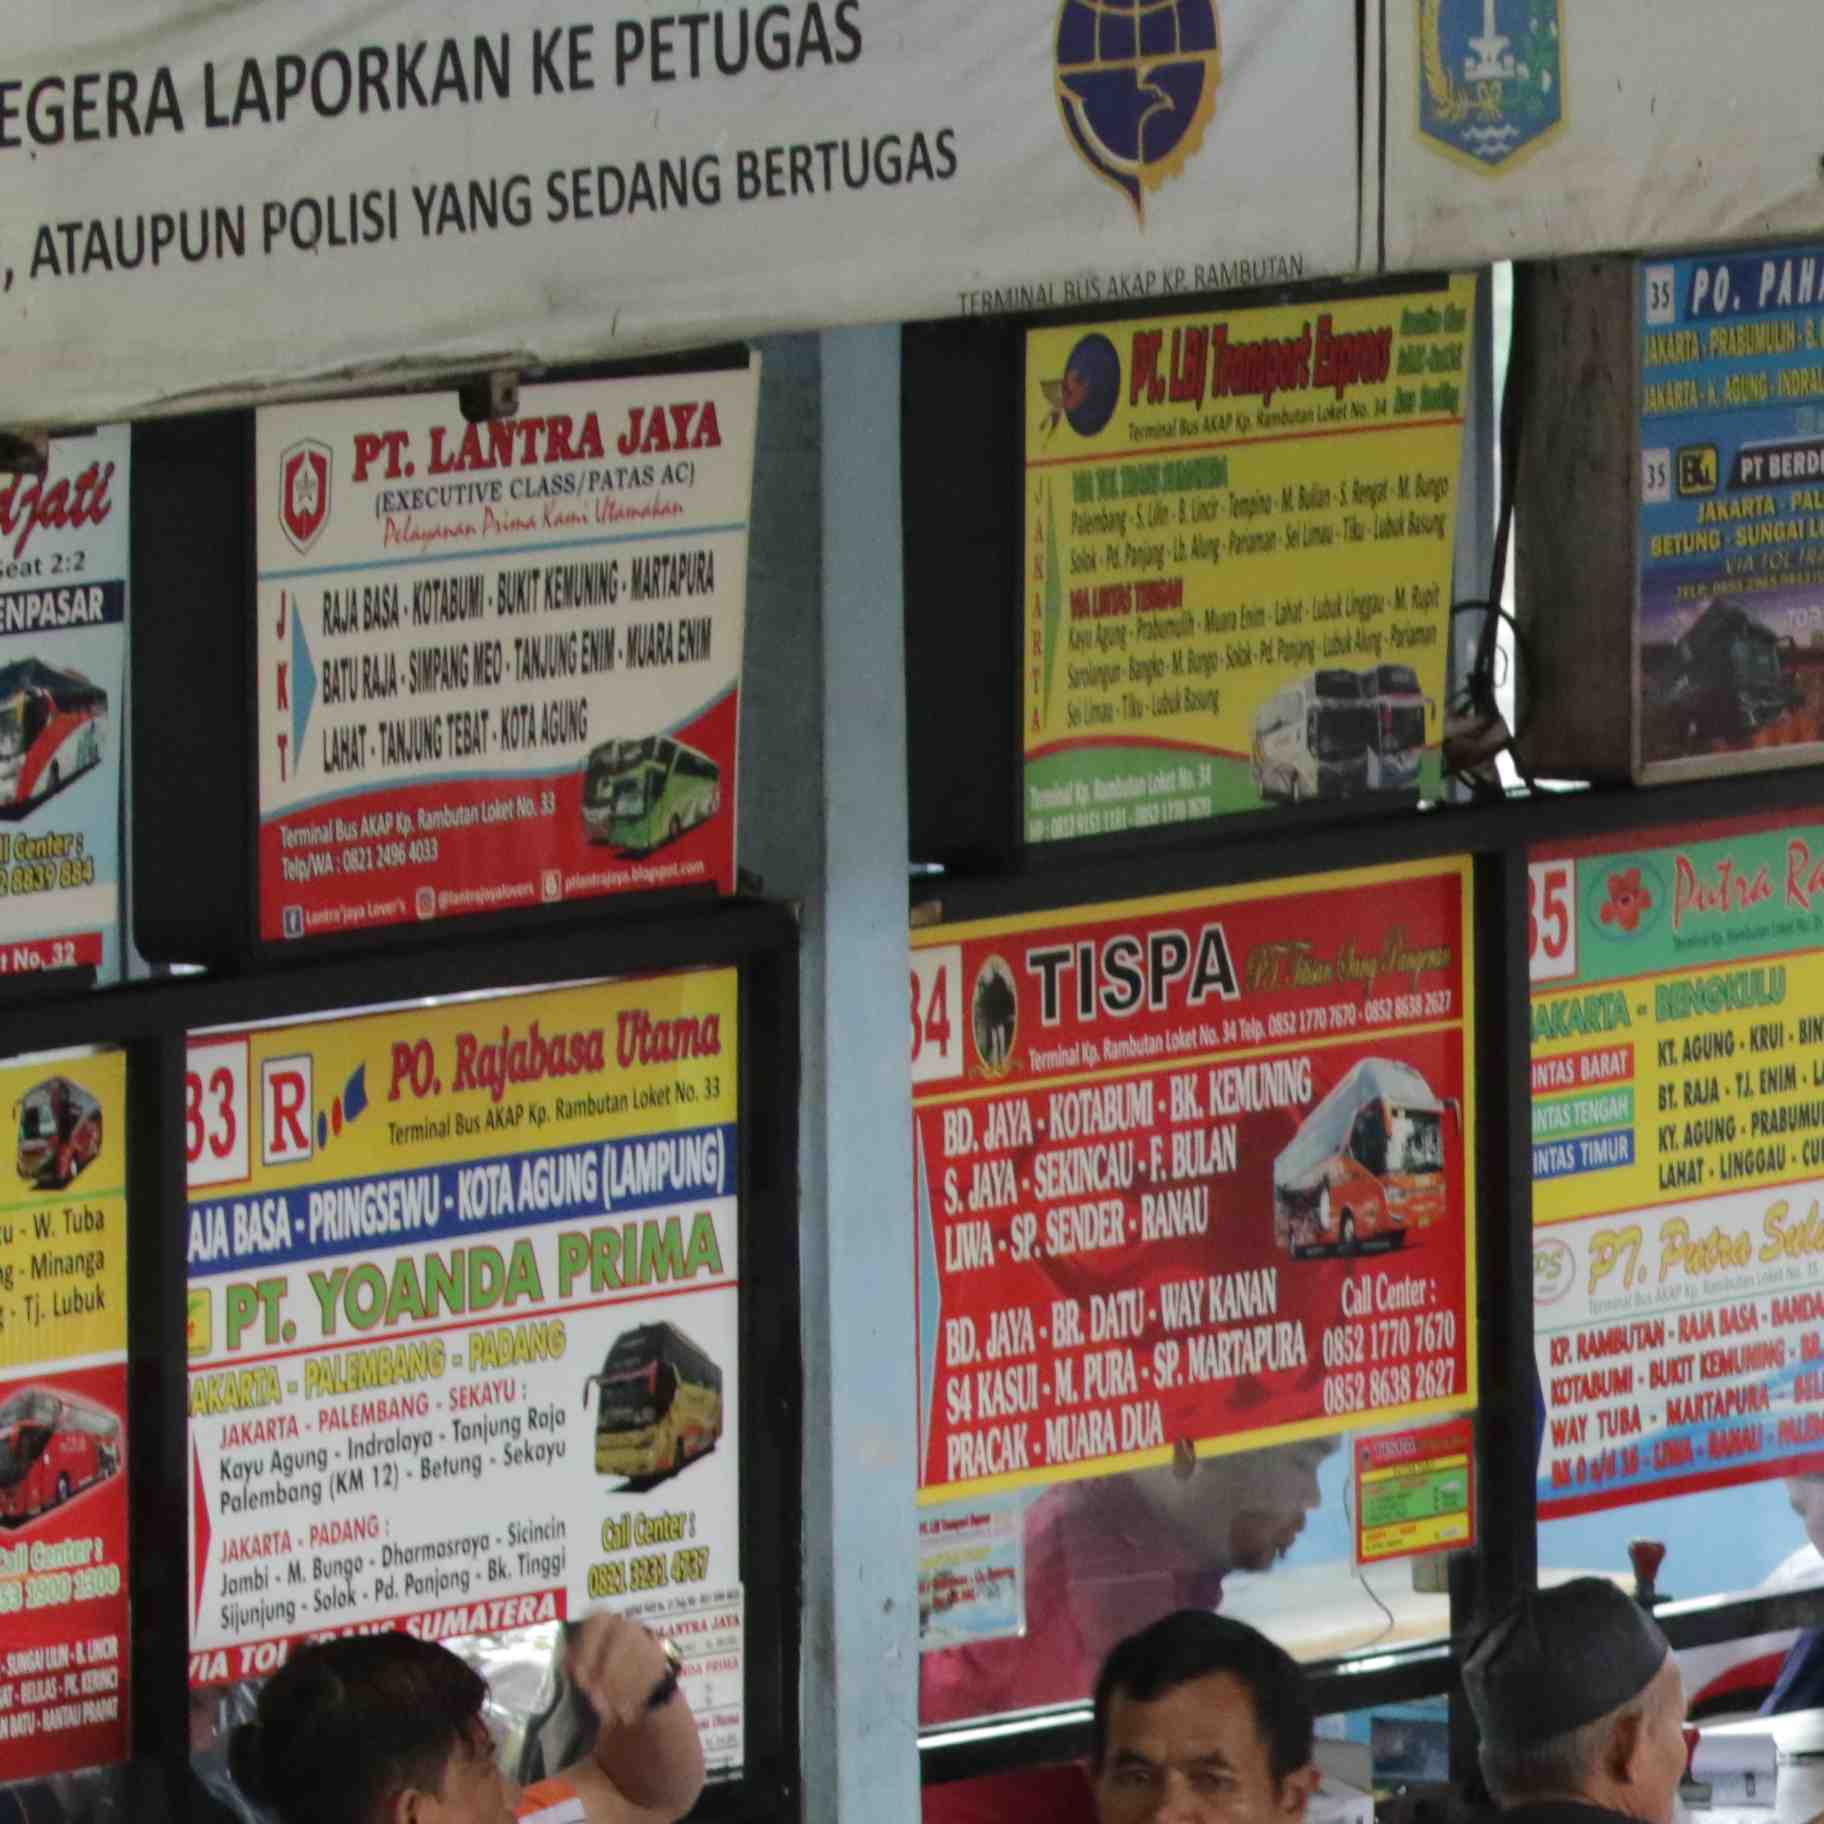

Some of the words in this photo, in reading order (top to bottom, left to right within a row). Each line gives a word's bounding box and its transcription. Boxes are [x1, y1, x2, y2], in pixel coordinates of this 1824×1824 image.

[205, 41, 512, 129] LAPORKAN
[533, 23, 594, 92] KE
[615, 0, 863, 88] PETUGAS
[30, 205, 246, 280] ATAUPUN
[263, 188, 397, 254] POLISI
[412, 176, 531, 237] YANG
[547, 155, 720, 223] SEDANG
[738, 129, 957, 199] BERTUGAS
[1651, 278, 1670, 311] 35
[1692, 263, 1740, 313] PO.
[353, 430, 415, 483] PT.
[428, 413, 604, 475] LANTRA
[618, 401, 721, 454] JAYA
[1741, 455, 1762, 481] PT
[322, 590, 358, 637] RAJA
[363, 585, 399, 630] BASA
[412, 575, 485, 624] KOTABUMI
[498, 569, 539, 615] BUKIT
[545, 559, 618, 611] KEMUNING
[631, 550, 714, 598] MARTAPURA
[1674, 854, 1772, 928] Putra
[1026, 922, 1240, 1029] TISPA
[388, 1040, 440, 1102] PO.
[453, 1023, 604, 1103] Rajabasa
[617, 1009, 721, 1067] Utama
[1580, 1049, 1628, 1080] BARAT
[1657, 1040, 1679, 1068] KT.
[1683, 1031, 1733, 1066] AGUNG
[1750, 1022, 1784, 1054] KRUI
[270, 1073, 309, 1153] R
[388, 1119, 449, 1147] Terminal
[454, 1112, 480, 1134] Bus
[485, 1105, 525, 1131] AKAP
[529, 1103, 550, 1129] Kp.
[555, 1093, 628, 1120] Rambutan
[632, 1087, 670, 1110] Loket
[675, 1081, 698, 1103] No.
[704, 1077, 721, 1101] 33
[944, 1107, 977, 1158] BD.
[984, 1099, 1032, 1151] JAYA
[1049, 1079, 1153, 1139] KOTABUMI
[1170, 1074, 1204, 1121] BK.
[1210, 1058, 1312, 1114] KEMUNING
[1580, 1137, 1629, 1167] TIMUR
[1658, 1159, 1703, 1190] LAHAT
[1720, 1144, 1785, 1182] LINGGAU
[33, 1212, 56, 1239] W.
[62, 1205, 105, 1234] Tuba
[234, 1198, 292, 1253] BASA
[309, 1173, 440, 1244] PRINGSEWU
[458, 1164, 513, 1222] KOTA
[518, 1148, 597, 1215] AGUNG
[603, 1128, 725, 1208] (LAMPUNG)
[32, 1249, 105, 1282] Minanga
[226, 1276, 296, 1351] PT.
[306, 1238, 544, 1337] YOANDA
[558, 1211, 723, 1298] PRIMA
[1341, 1276, 1371, 1315] Call
[1375, 1276, 1425, 1310] Center
[24, 1294, 46, 1325] Tj.
[52, 1286, 105, 1314] Lubuk
[1322, 1325, 1363, 1367] 0852
[1370, 1320, 1409, 1360] 1770
[1413, 1311, 1455, 1351] 7670
[220, 1417, 299, 1450] JAKARTA
[318, 1390, 429, 1431] PALEMBANG
[448, 1379, 518, 1409] SEKAYU
[946, 1424, 1029, 1481] PRACAK
[1045, 1408, 1116, 1465] MUARA
[1122, 1402, 1163, 1449] DUA
